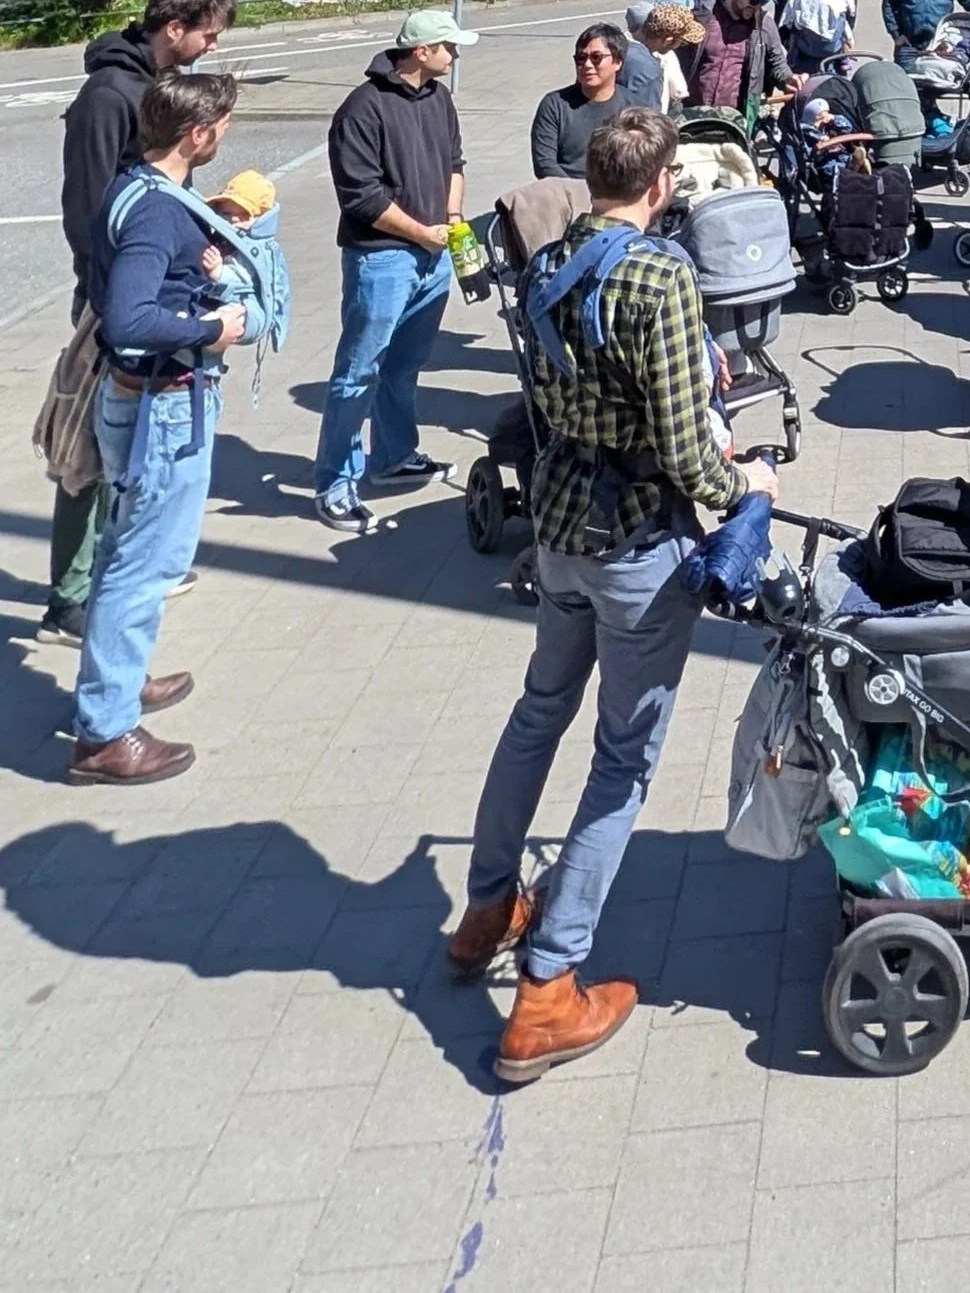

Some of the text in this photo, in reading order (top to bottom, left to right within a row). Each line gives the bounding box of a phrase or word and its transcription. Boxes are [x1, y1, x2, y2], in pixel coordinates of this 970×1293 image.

[904, 688, 944, 723] TAX GO BIG
